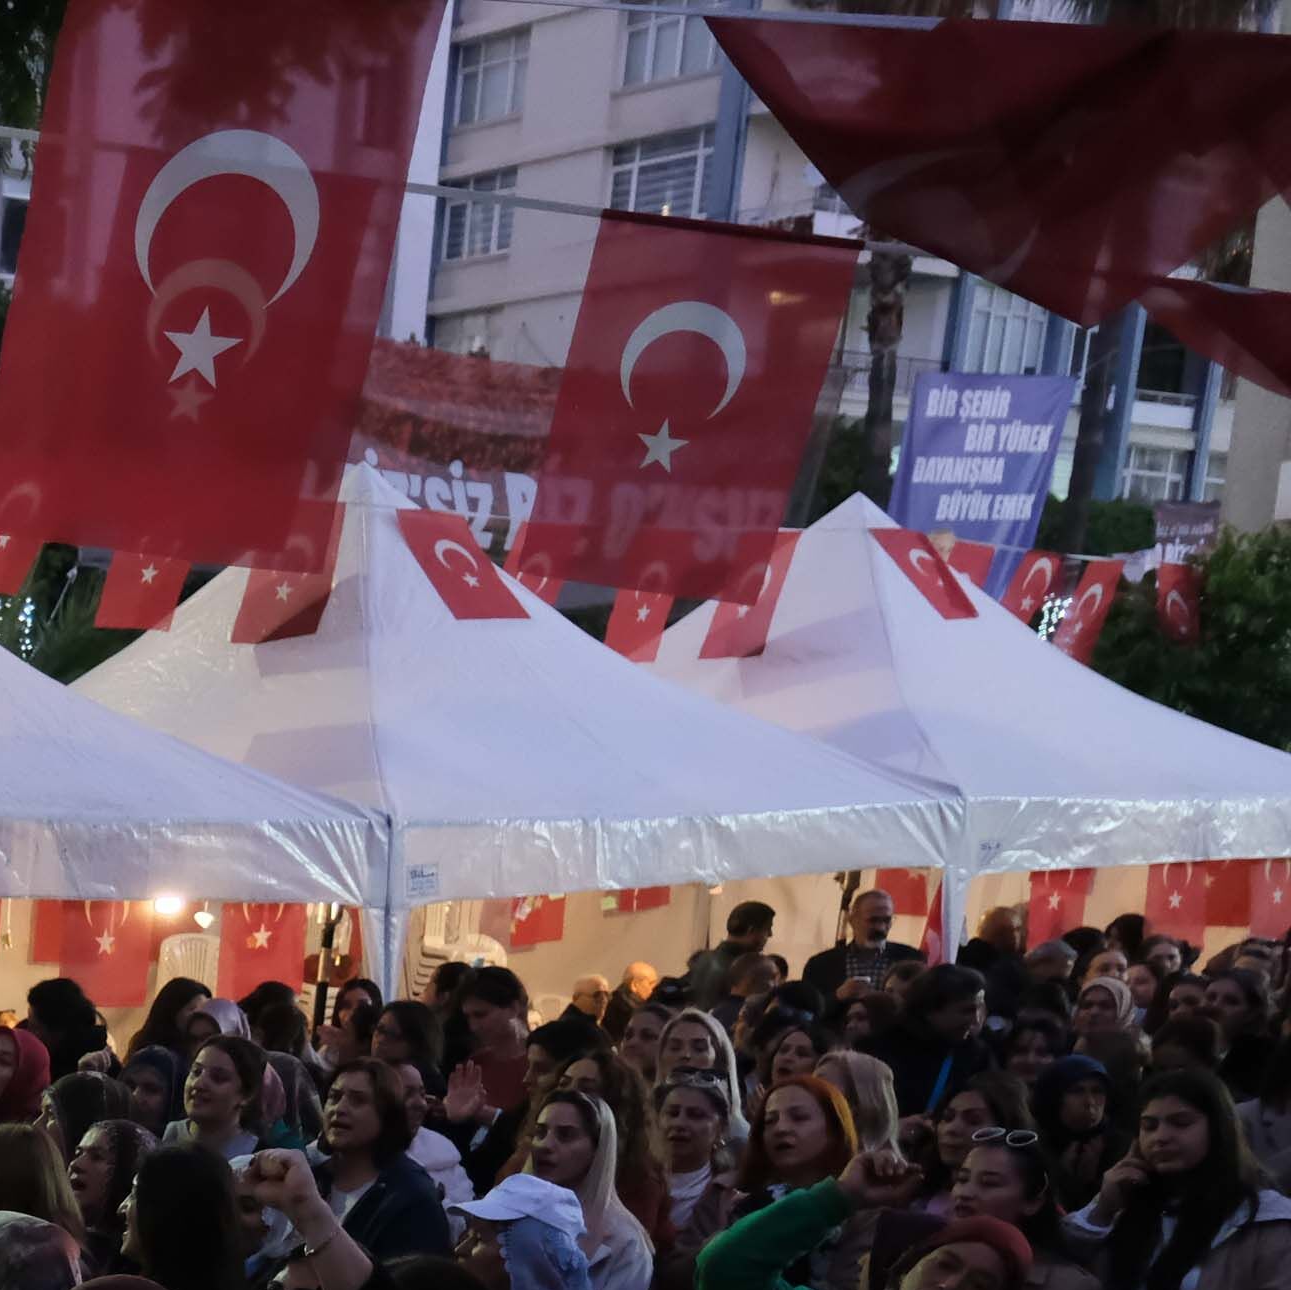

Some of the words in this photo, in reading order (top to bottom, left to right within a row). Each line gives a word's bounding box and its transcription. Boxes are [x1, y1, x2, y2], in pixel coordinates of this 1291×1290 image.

[926, 384, 959, 418] BİR
[959, 385, 1012, 423] ŞEHİR
[964, 419, 997, 452] BİR
[912, 456, 1006, 488] DAYANIŞMA
[935, 490, 994, 522] BÜYÜK
[992, 493, 1036, 521] EMEK
